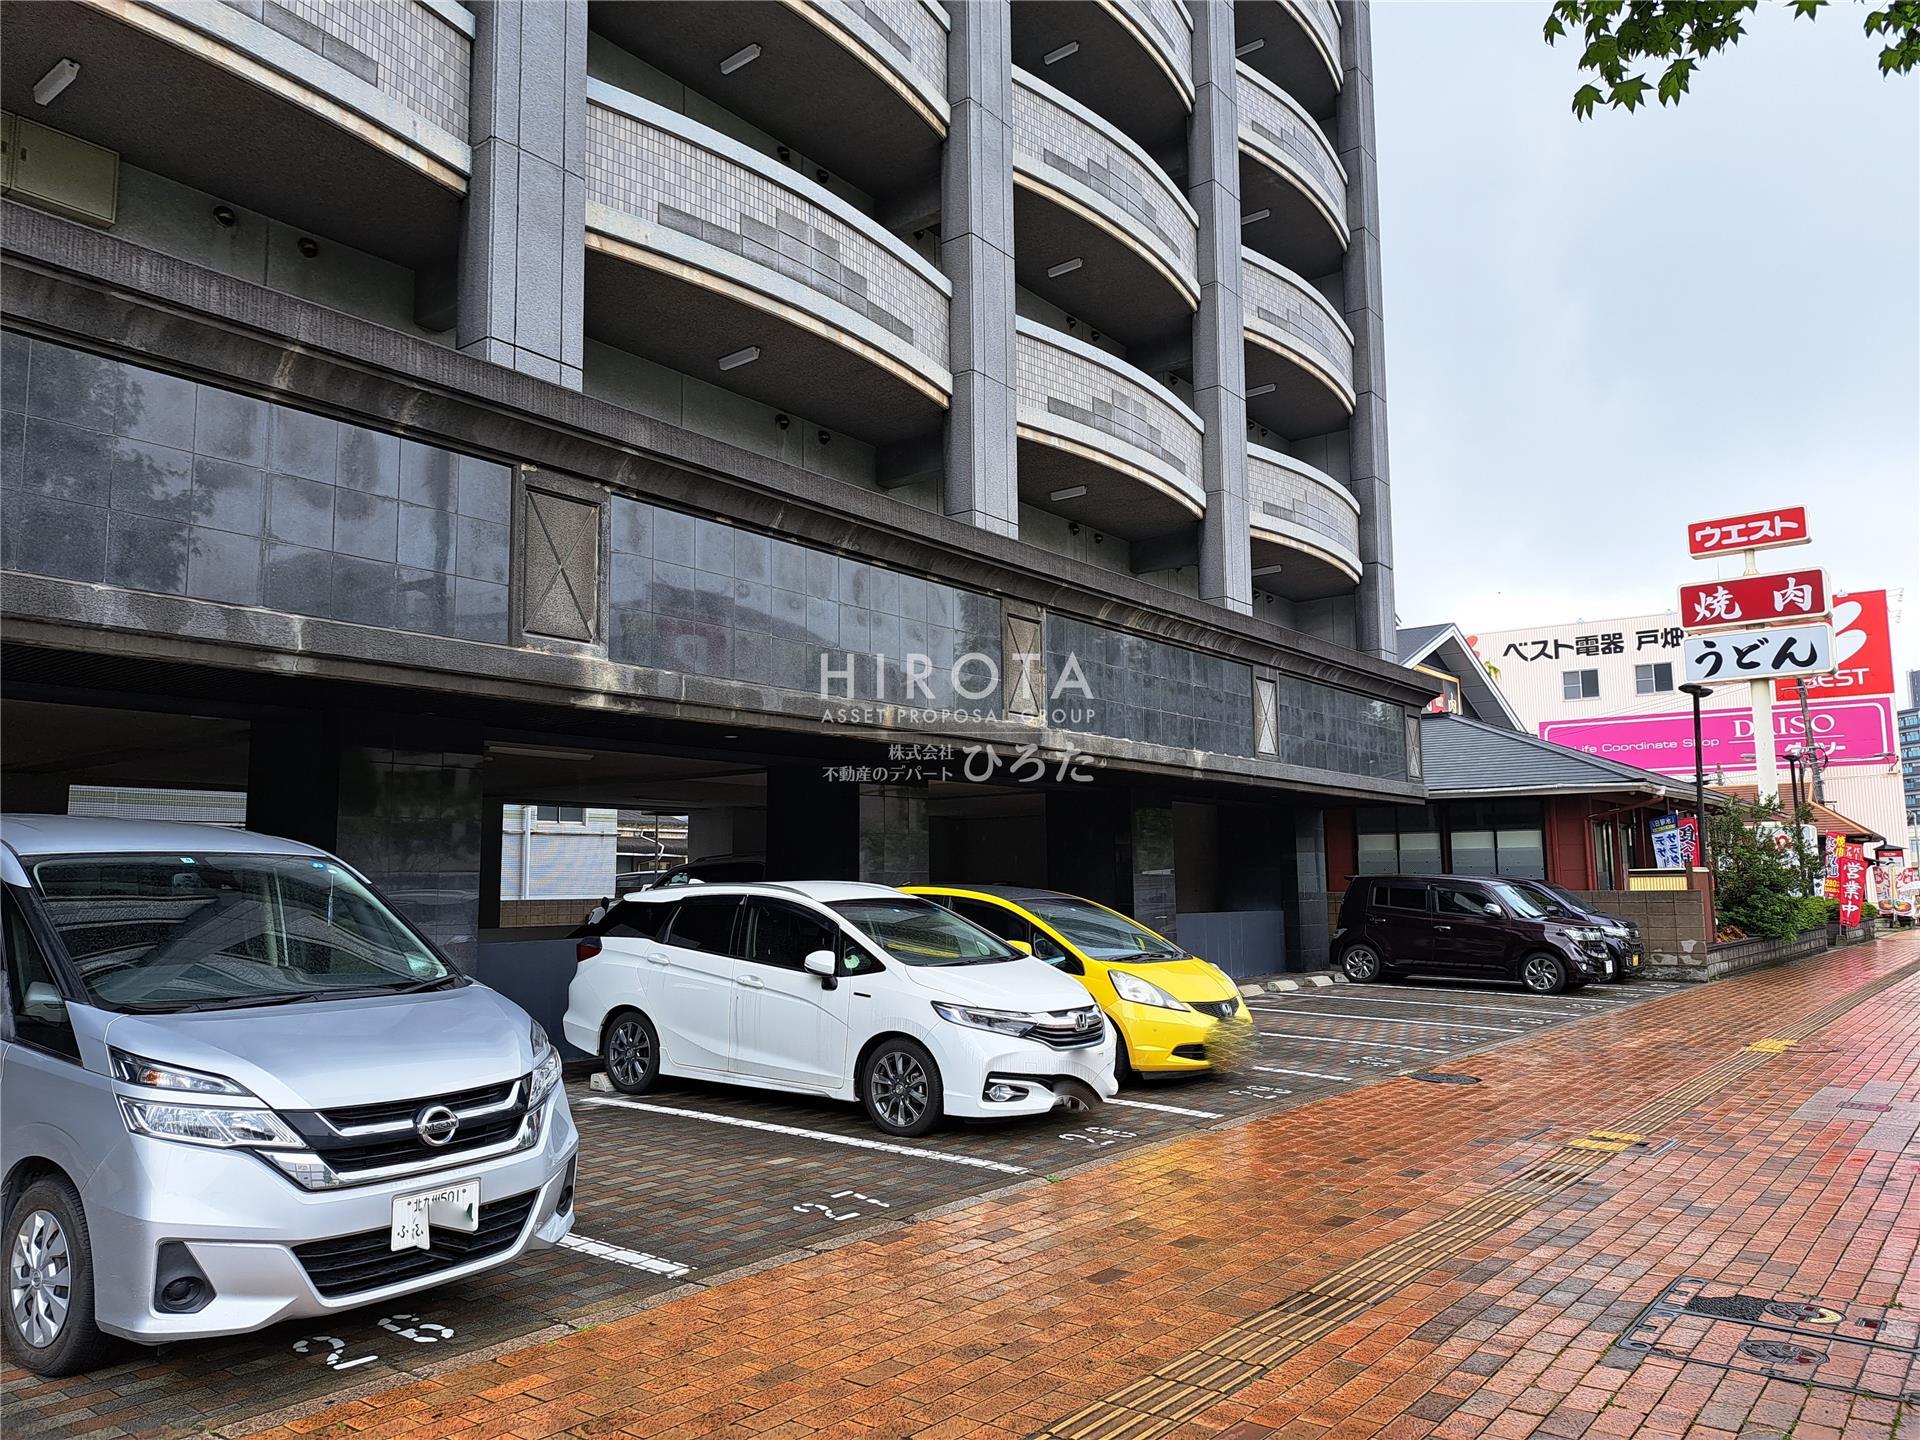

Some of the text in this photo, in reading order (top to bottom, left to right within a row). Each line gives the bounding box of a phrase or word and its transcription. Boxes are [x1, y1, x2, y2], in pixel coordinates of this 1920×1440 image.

[1696, 516, 1799, 547] ウエスト
[1503, 633, 1625, 662] ベスト電器
[1695, 637, 1818, 678] うどん
[1733, 714, 1836, 737] DISO
[1602, 741, 1678, 753] Coordinate
[1683, 738, 1720, 749] Sop
[1842, 862, 1865, 917] 営業中
[1058, 1127, 1137, 1146] 28
[793, 1190, 890, 1221] 27
[292, 1314, 455, 1370] 26
